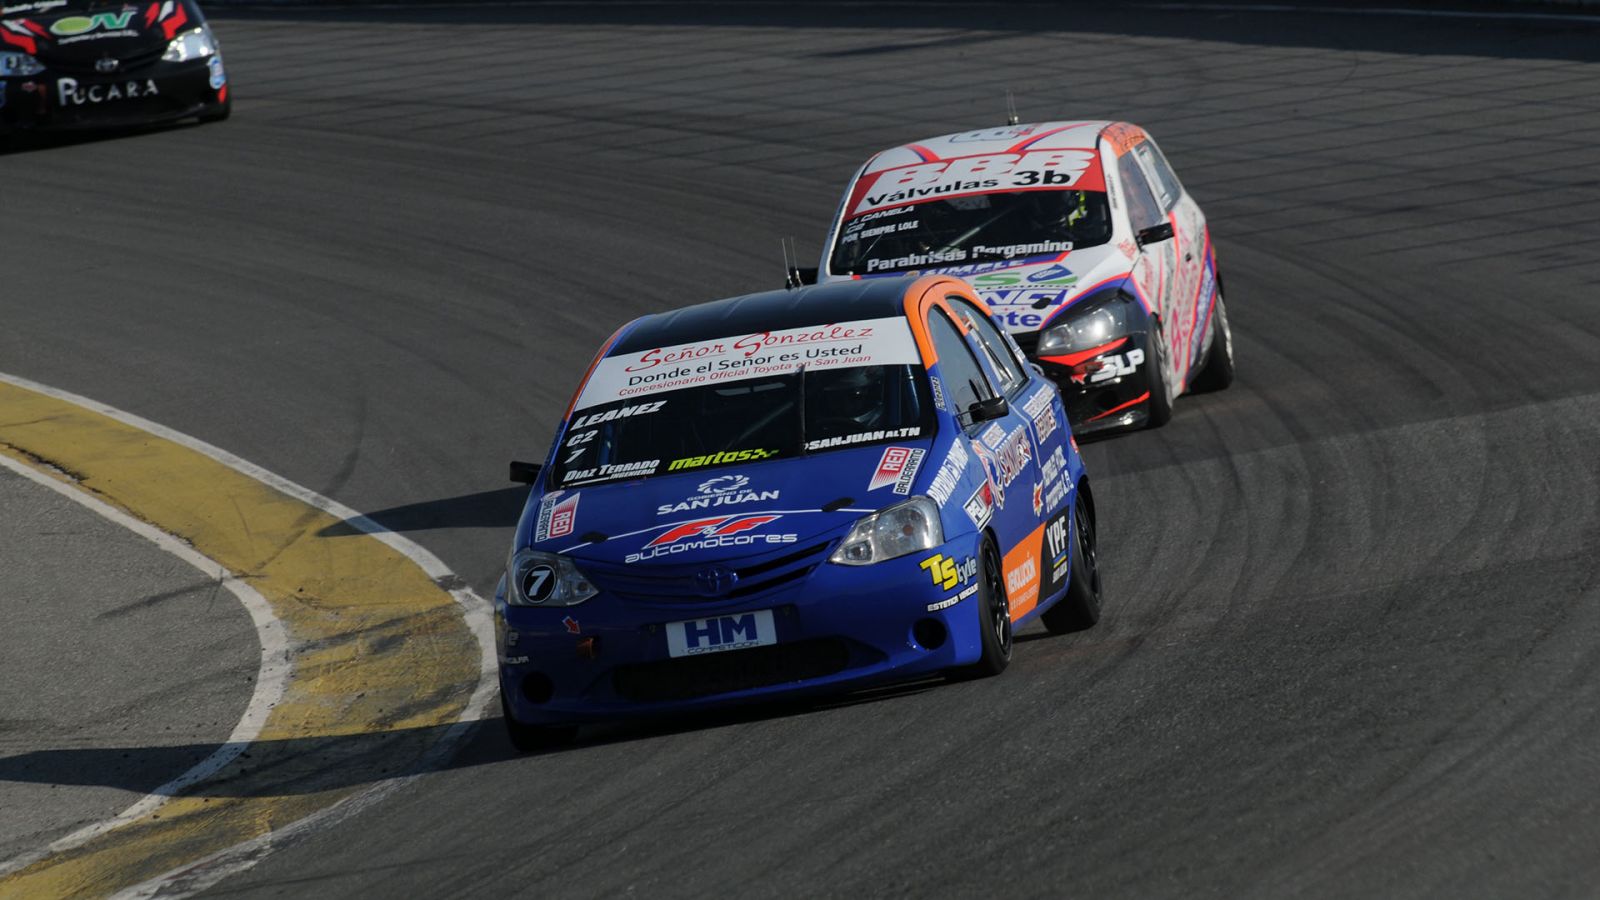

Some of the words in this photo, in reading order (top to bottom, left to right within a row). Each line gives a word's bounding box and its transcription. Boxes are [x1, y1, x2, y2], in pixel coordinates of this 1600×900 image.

[57, 78, 160, 107] PUCARA
[868, 150, 1096, 190] BBB
[867, 178, 998, 206] Válvulas
[1013, 170, 1071, 187] 3b
[867, 248, 967, 272] Parabrisas
[972, 239, 1074, 259] Pergamino
[625, 343, 726, 373] Señor
[733, 322, 873, 357] González
[619, 374, 706, 396] Concesionario
[710, 367, 749, 381] Oficial
[752, 362, 792, 376] Toyota
[809, 357, 833, 367] San
[837, 354, 871, 365] Juan
[628, 366, 691, 387] Donde
[698, 362, 713, 375] el
[719, 355, 773, 371] Señor
[779, 352, 799, 362] es
[806, 344, 863, 359] Usted
[1090, 348, 1145, 383] SLP
[570, 400, 668, 431] LEANEZ
[566, 429, 598, 447] C2
[599, 459, 661, 476] TERRADO
[881, 449, 909, 471] RED
[656, 499, 710, 516] SAN
[713, 490, 779, 507] JUAN
[624, 533, 798, 564] automotores
[1046, 515, 1066, 558] YPF
[528, 569, 551, 597] 7
[685, 614, 758, 648] HM
